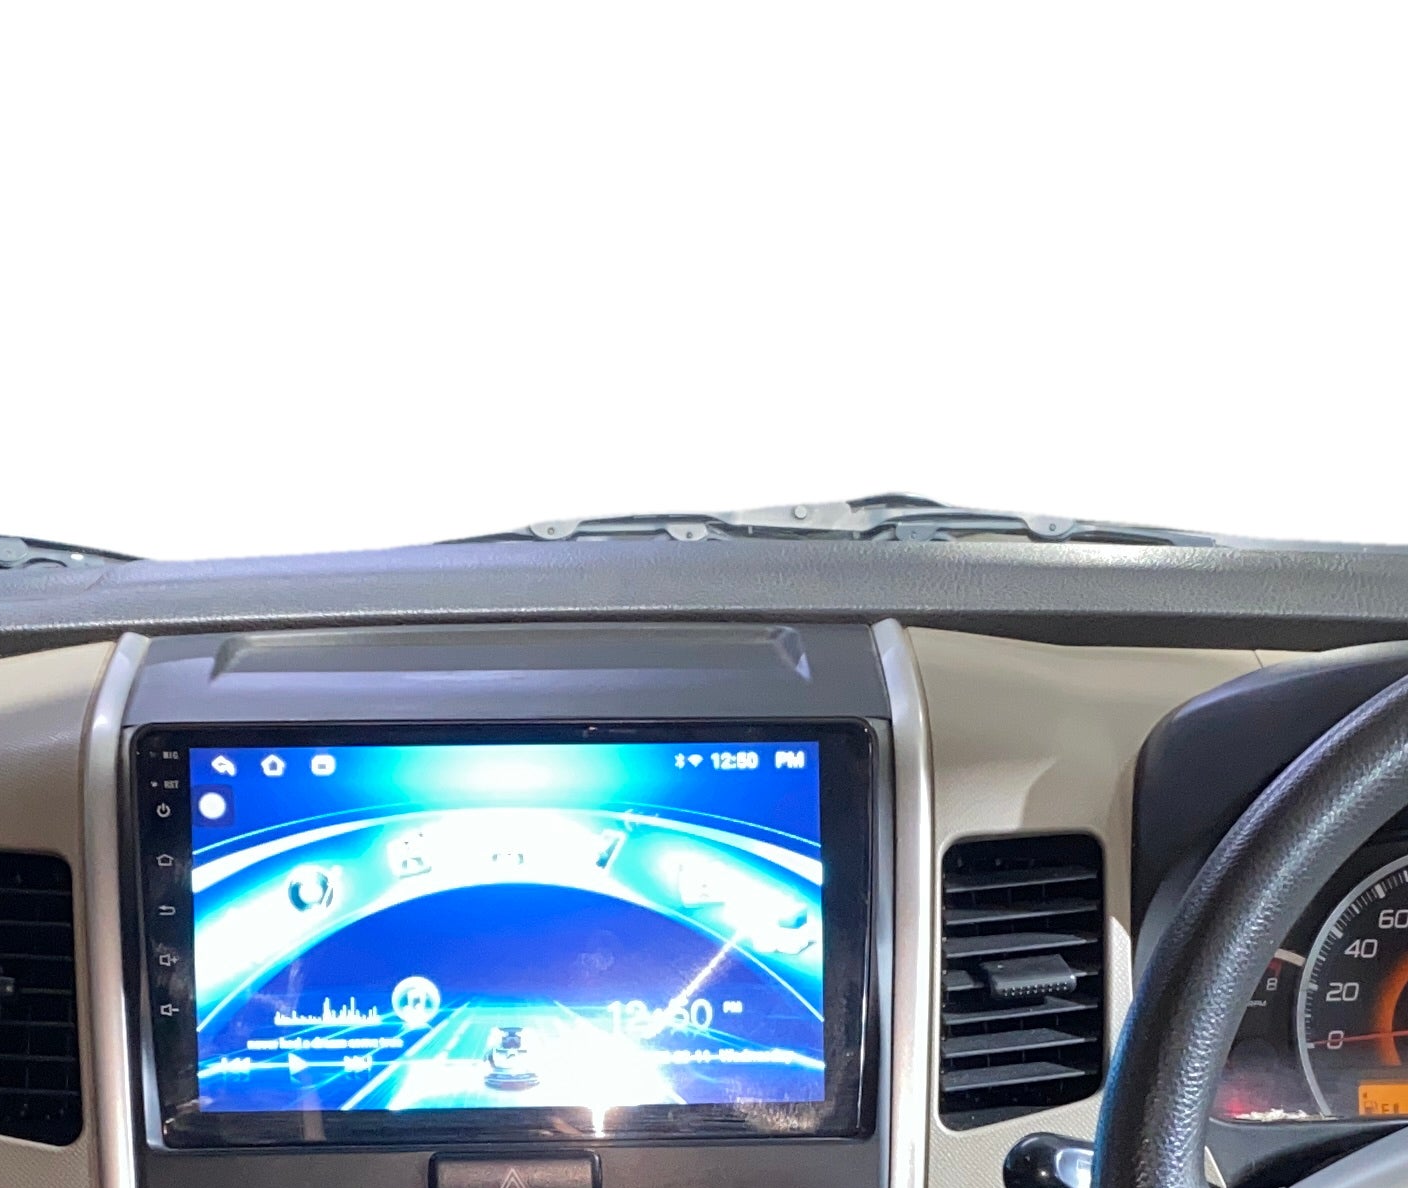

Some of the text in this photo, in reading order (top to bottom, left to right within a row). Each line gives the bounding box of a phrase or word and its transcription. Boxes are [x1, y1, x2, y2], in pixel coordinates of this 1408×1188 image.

[710, 751, 805, 770] 12:50 PM
[1344, 939, 1378, 958] 40
[1266, 978, 1278, 991] 8
[1326, 982, 1359, 1002] 20
[1327, 1030, 1344, 1049] 0
